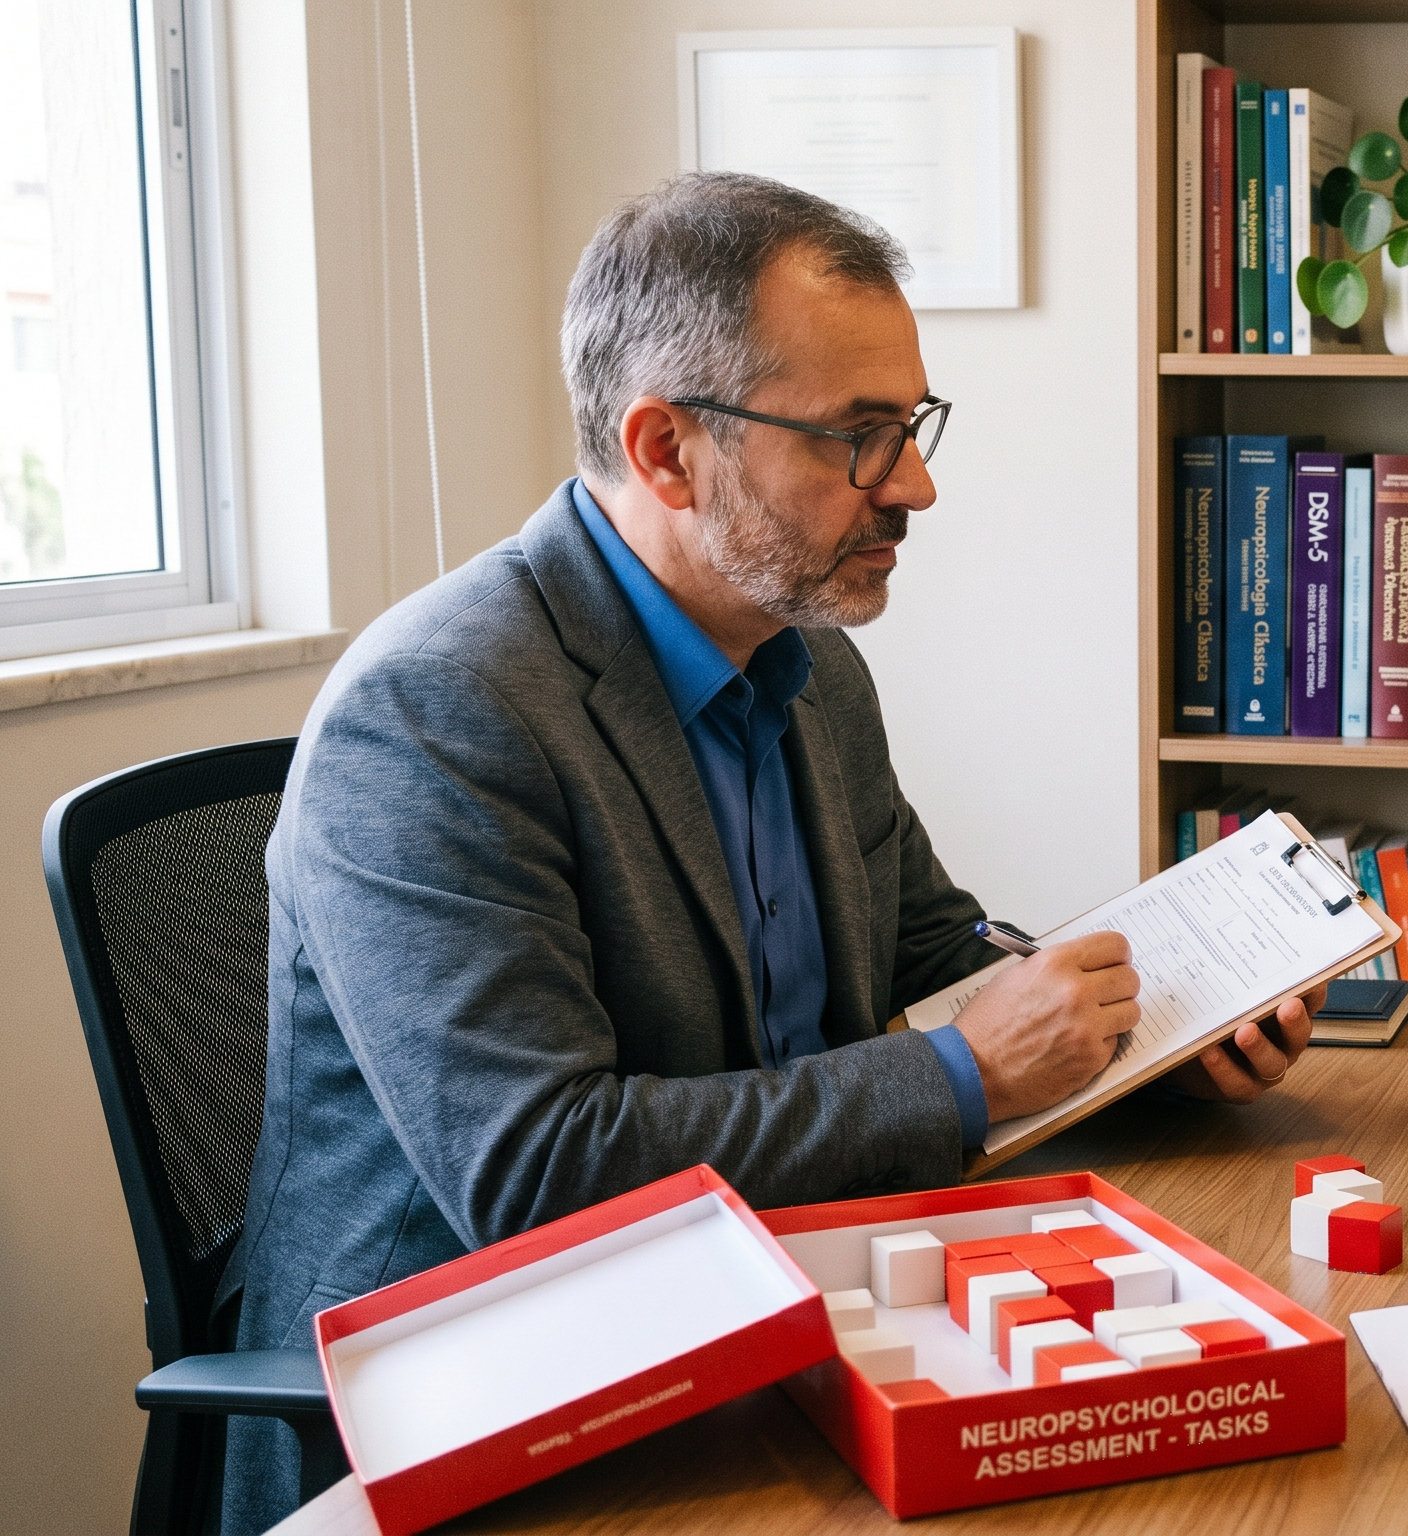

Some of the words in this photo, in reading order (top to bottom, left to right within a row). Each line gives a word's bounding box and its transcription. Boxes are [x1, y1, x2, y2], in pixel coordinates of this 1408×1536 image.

[1194, 487, 1213, 616] Neuropsicologia
[1251, 486, 1271, 616] Neuropsicologia
[1307, 491, 1329, 562] DSM-5
[961, 1379, 1285, 1450] NEUROPSYCHOLOGICAL
[975, 1429, 1161, 1480] ASSESSMENT
[1185, 1410, 1270, 1446] TASKS
